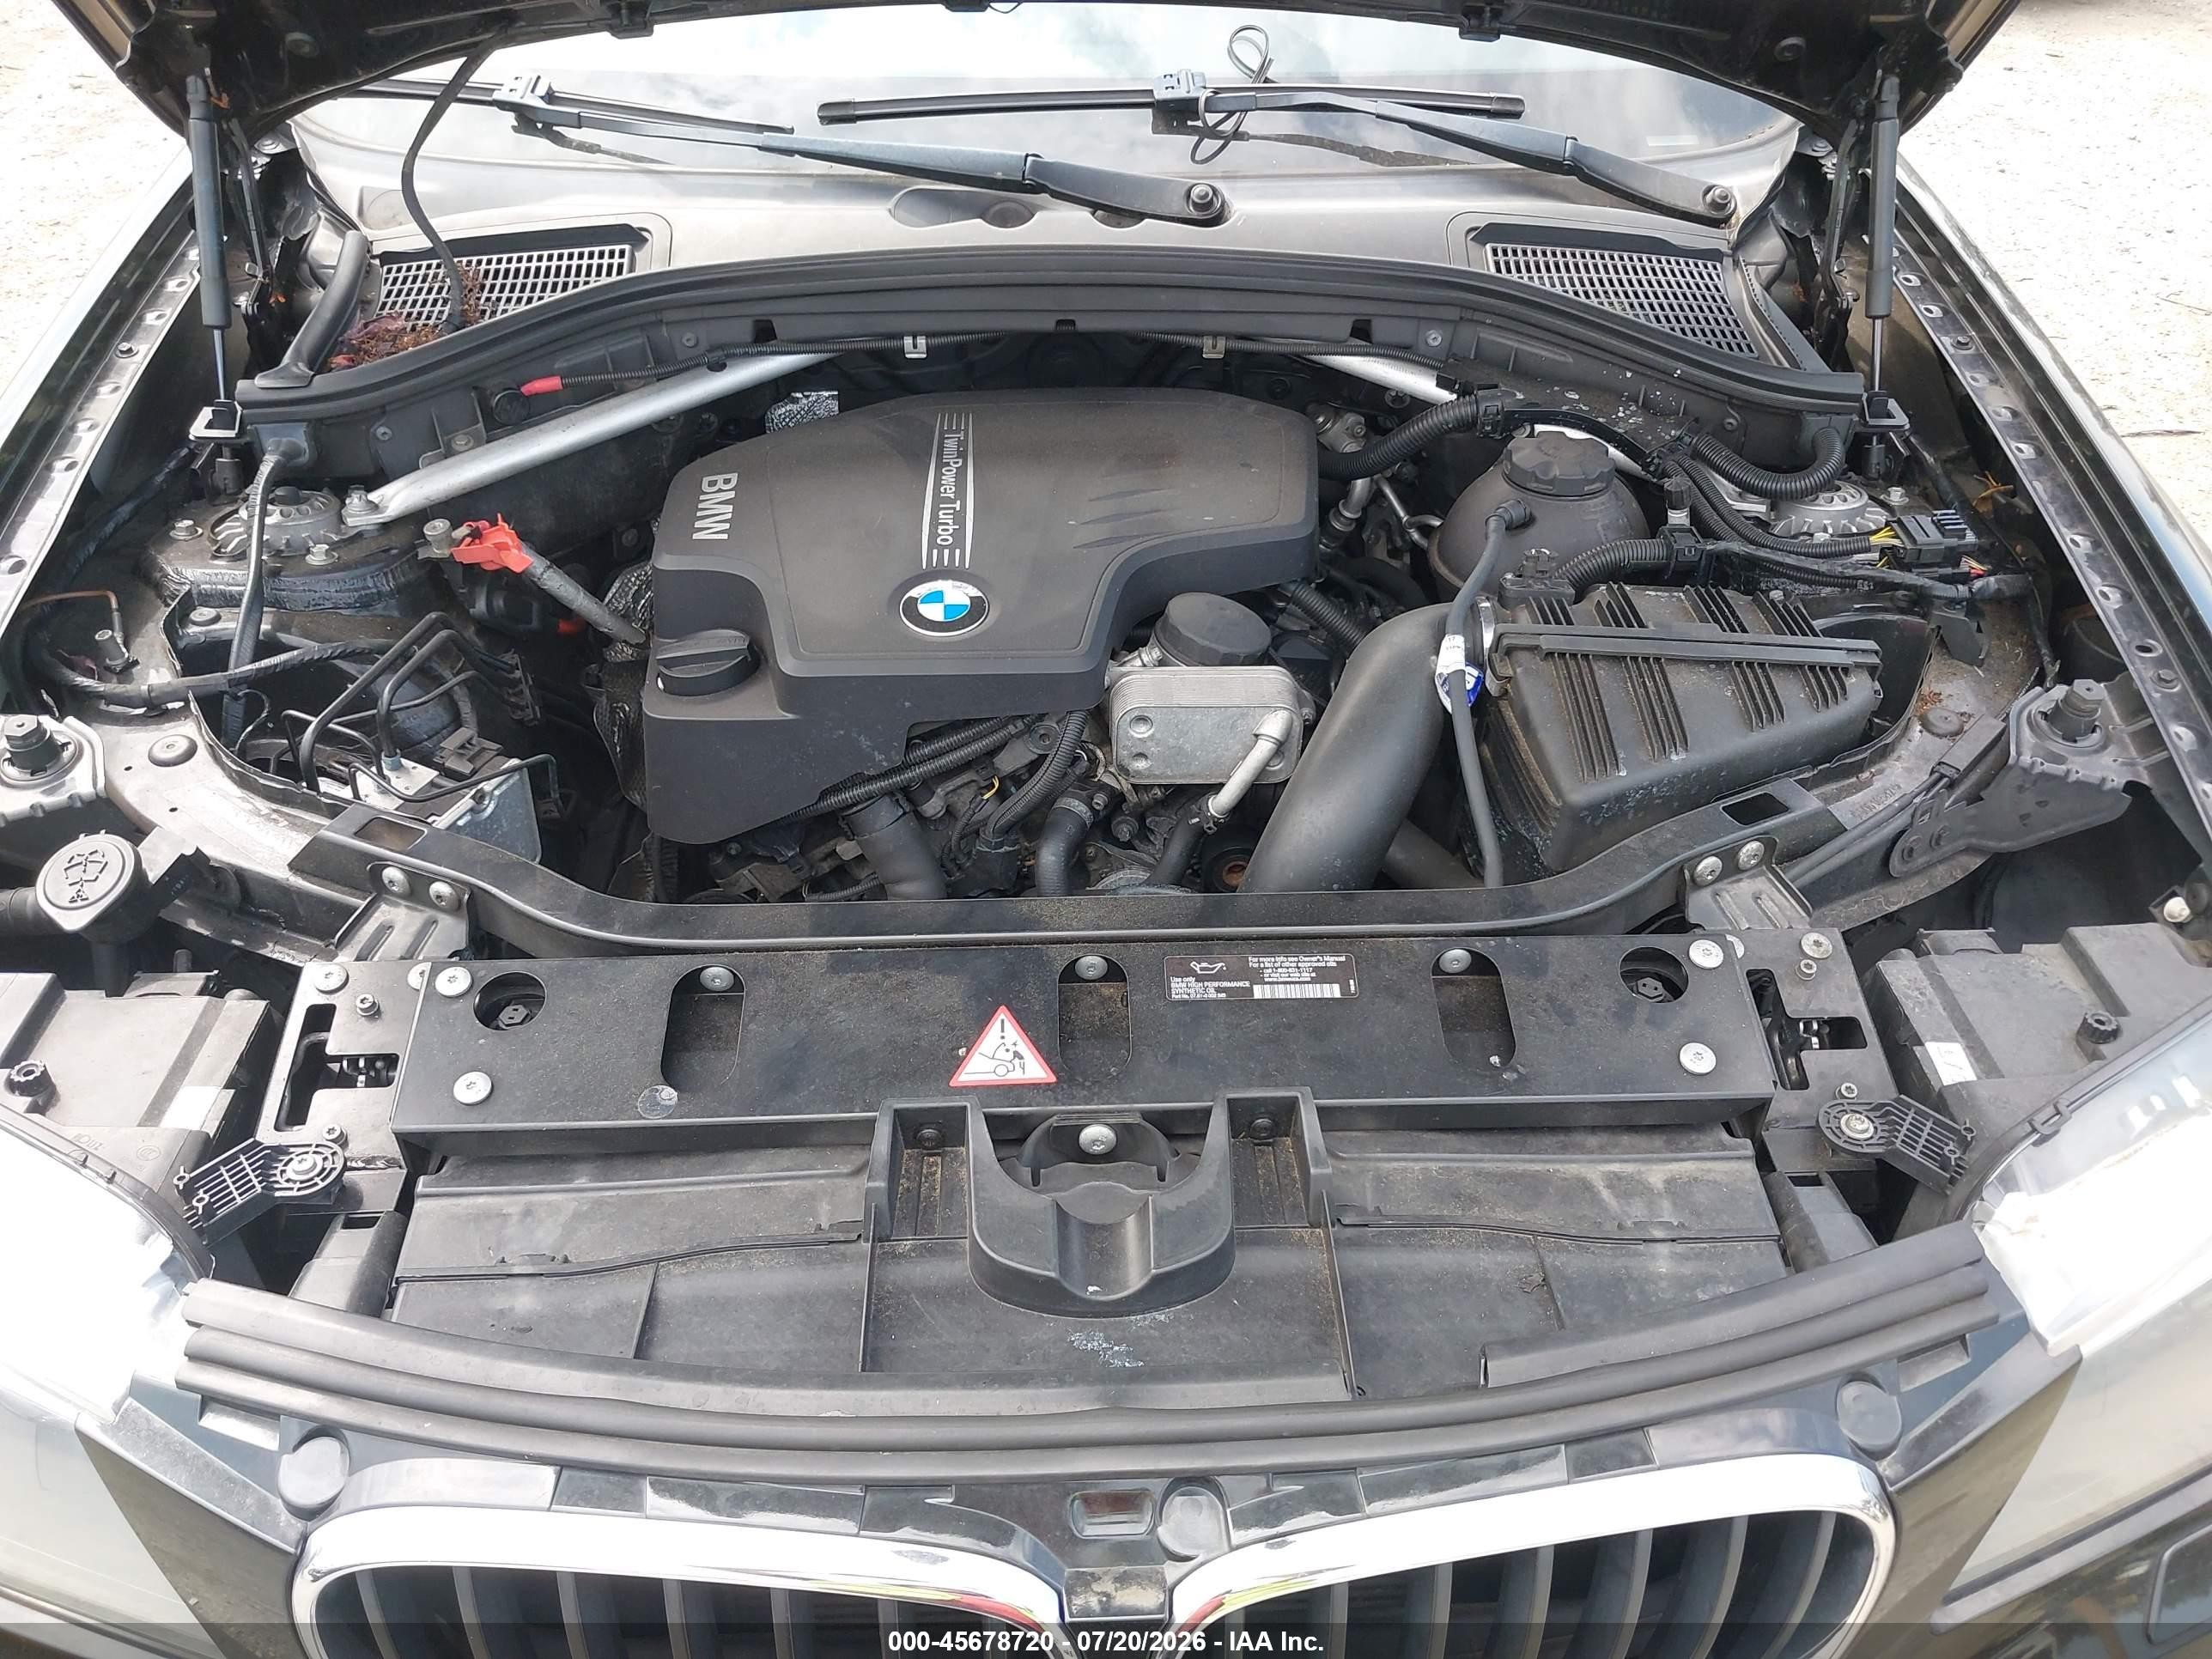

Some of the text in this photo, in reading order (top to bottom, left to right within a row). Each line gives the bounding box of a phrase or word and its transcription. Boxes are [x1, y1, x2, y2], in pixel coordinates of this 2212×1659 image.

[692, 472, 738, 540] BMW
[936, 431, 965, 546] TwinPower Turbo
